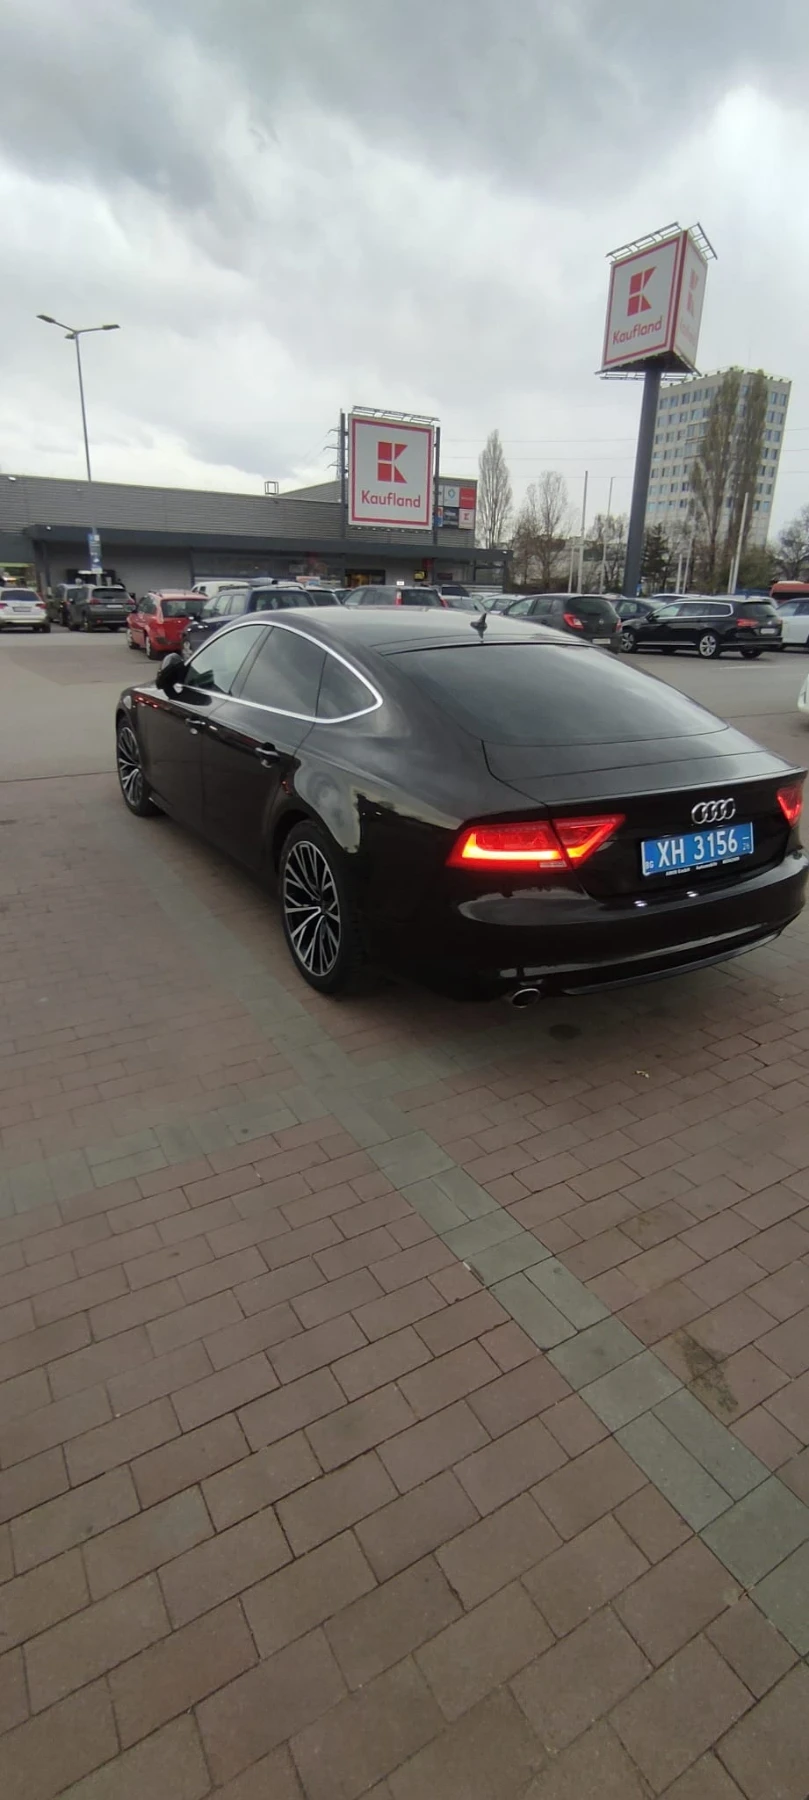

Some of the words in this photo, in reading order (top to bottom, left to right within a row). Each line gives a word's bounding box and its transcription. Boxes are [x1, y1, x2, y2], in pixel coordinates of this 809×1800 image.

[612, 316, 663, 345] Kaufland
[361, 490, 421, 508] Kaufland
[657, 838, 685, 867] XH
[694, 829, 738, 860] 3156
